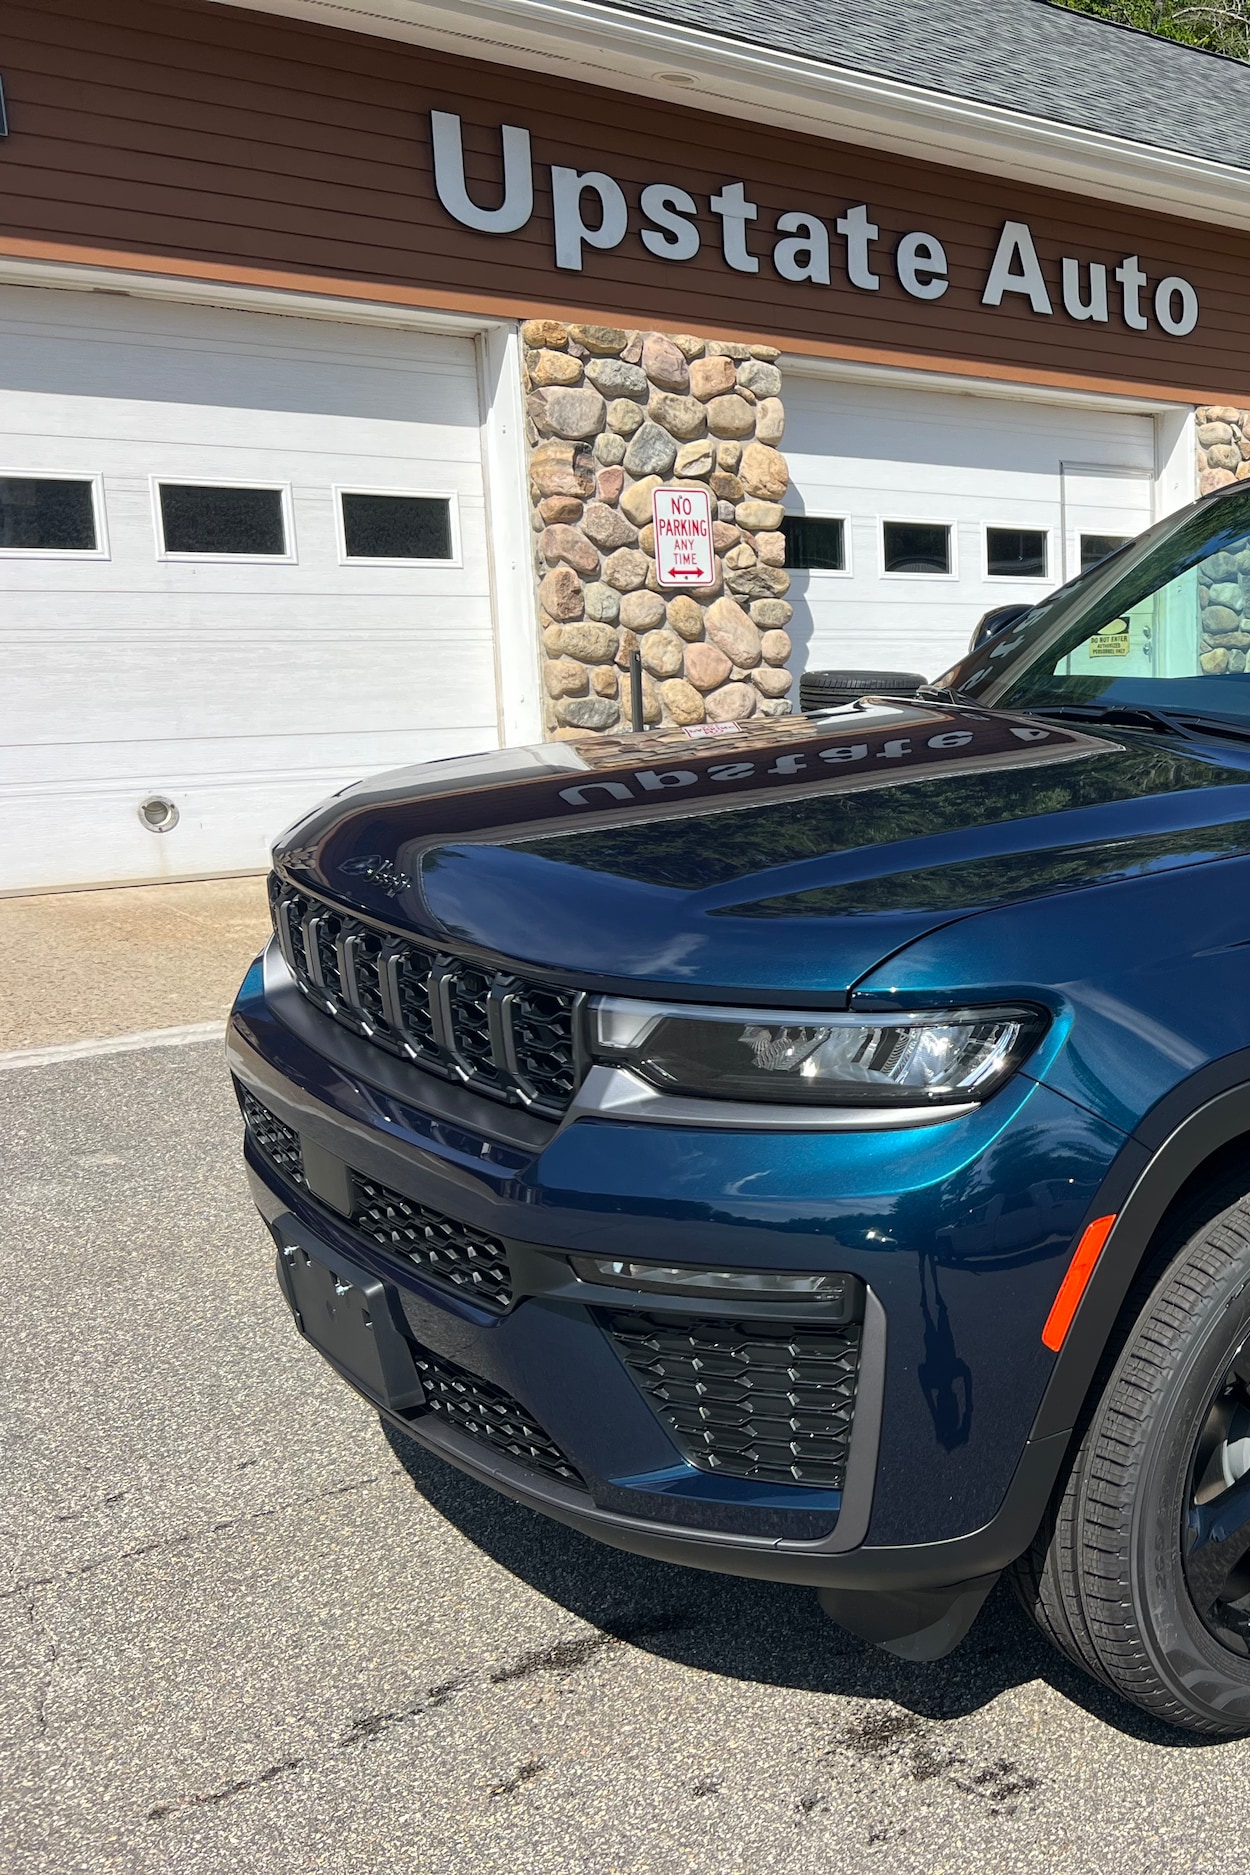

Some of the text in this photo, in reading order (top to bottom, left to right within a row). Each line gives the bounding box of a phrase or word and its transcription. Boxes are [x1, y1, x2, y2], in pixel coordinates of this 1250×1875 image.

[431, 109, 1200, 337] Upstate Auto
[671, 498, 692, 515] NO
[659, 519, 707, 537] PARKING
[674, 539, 694, 550] ANY
[673, 553, 697, 565] TIME
